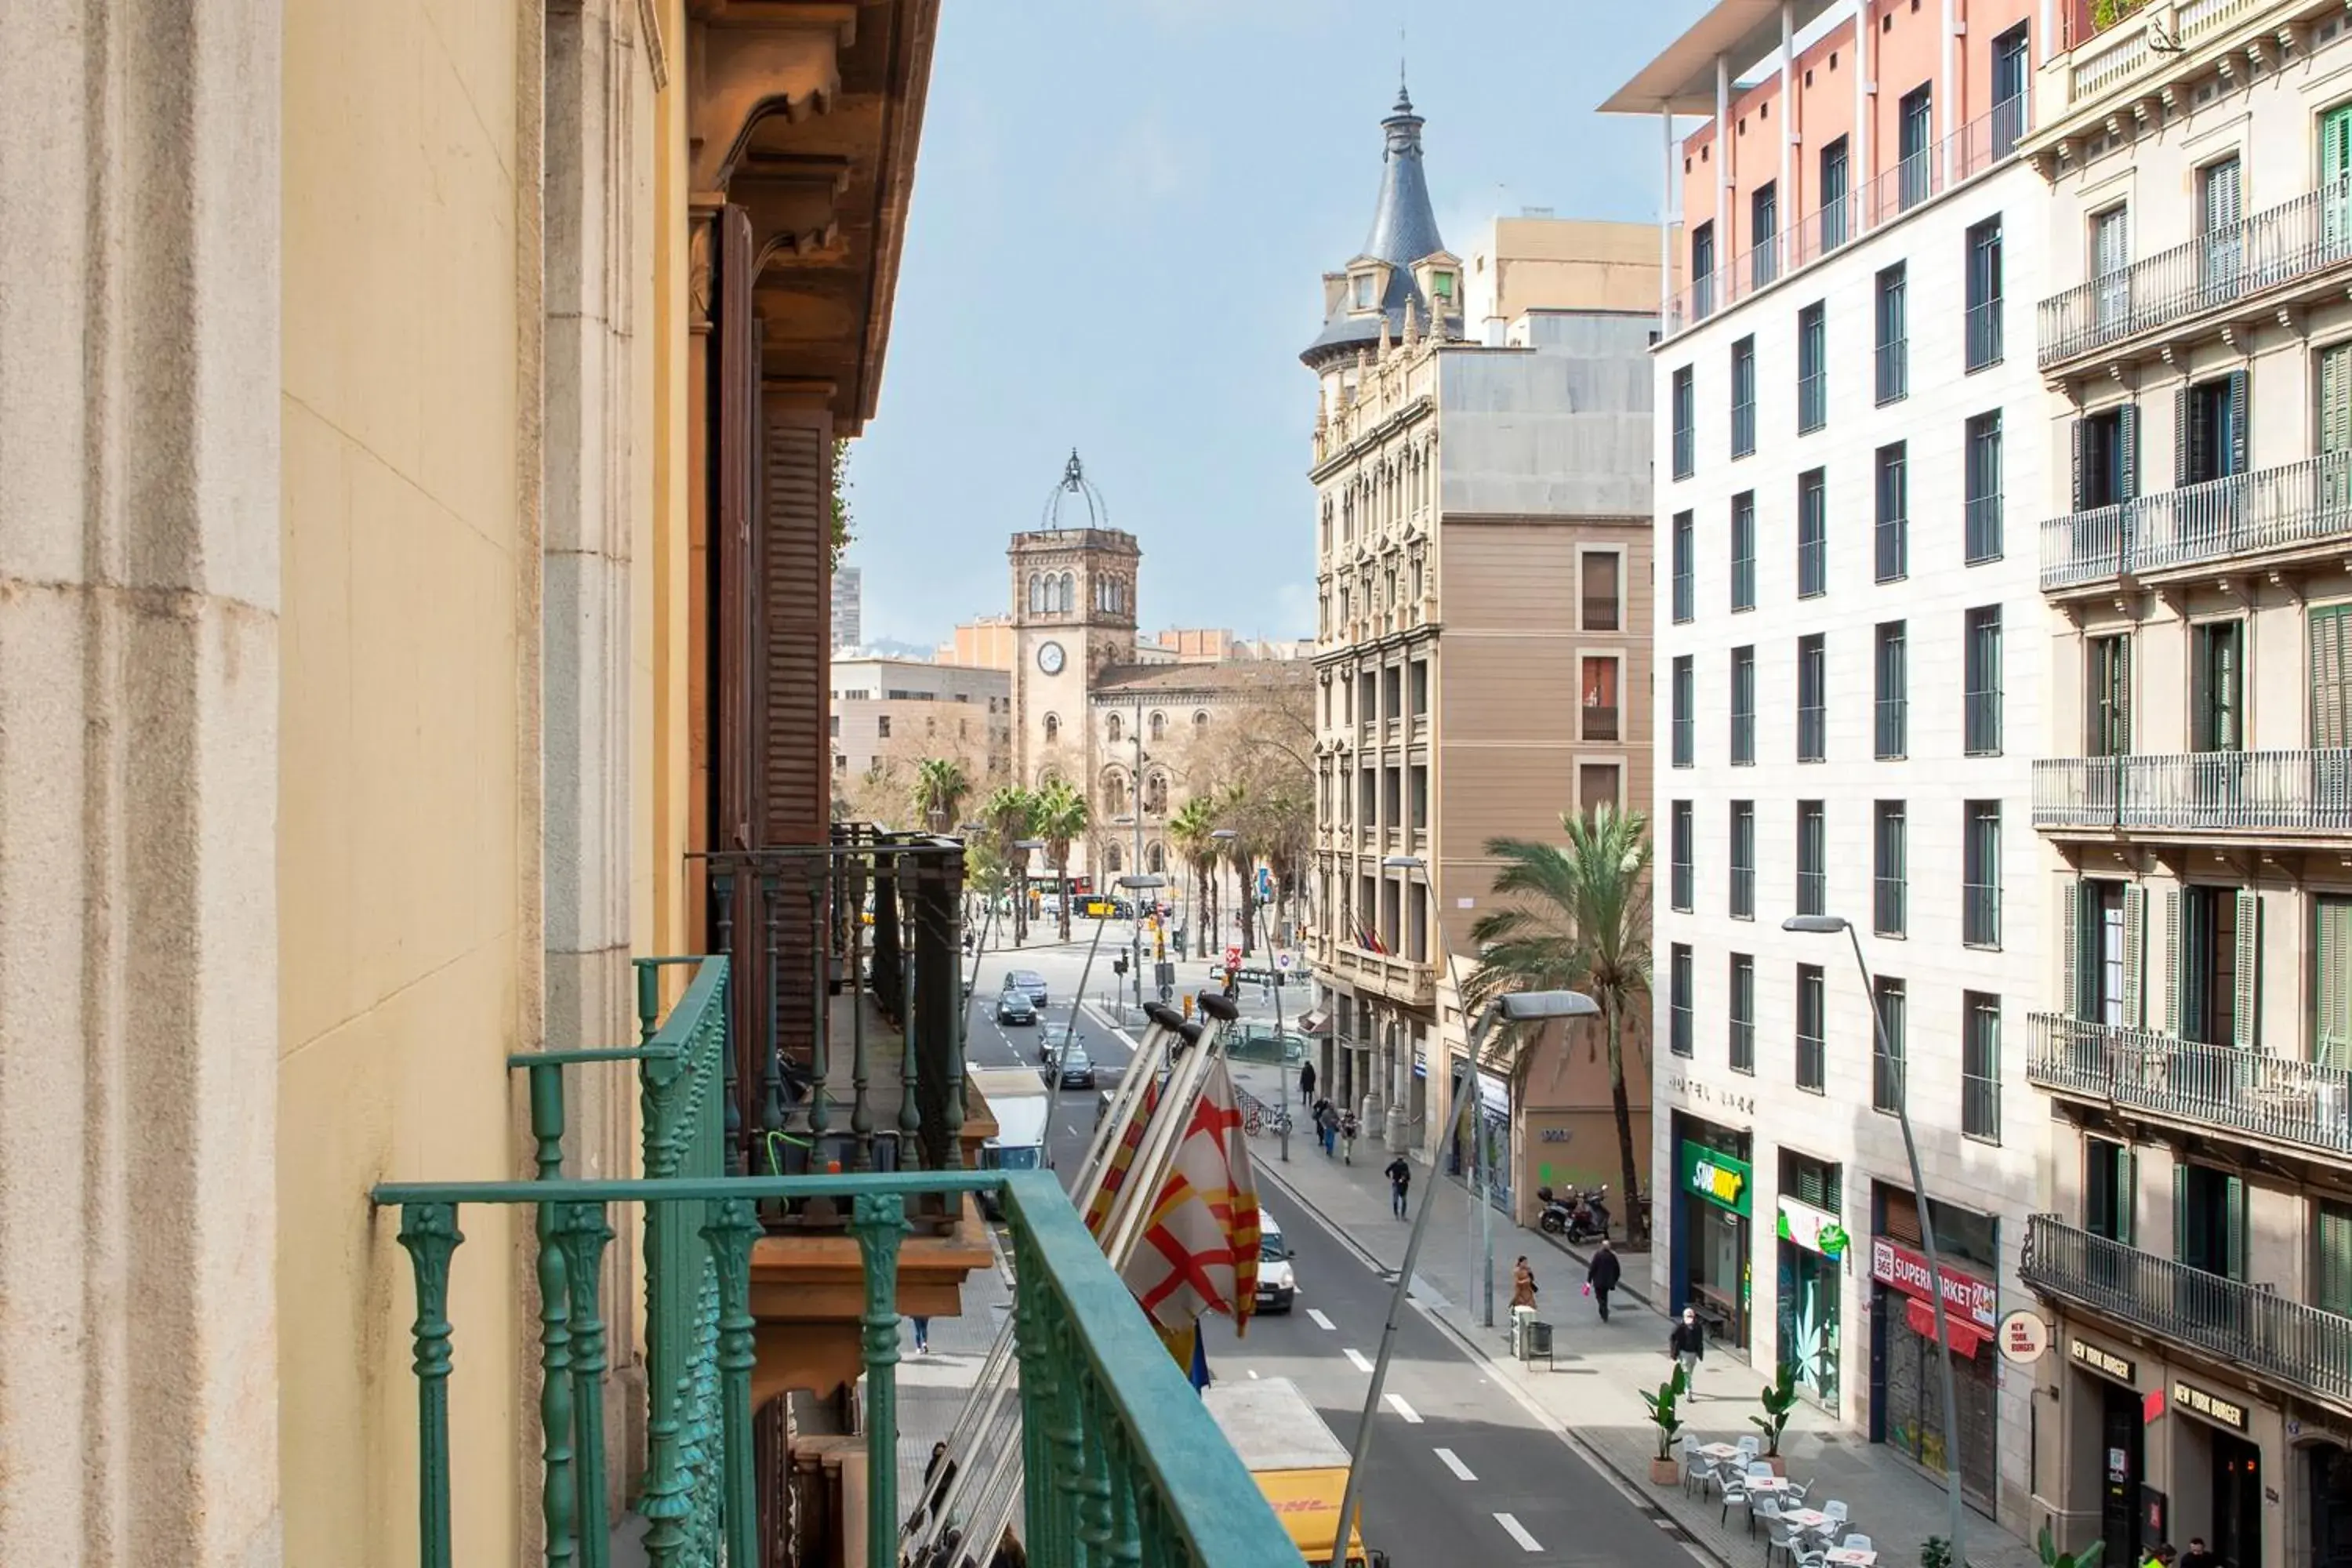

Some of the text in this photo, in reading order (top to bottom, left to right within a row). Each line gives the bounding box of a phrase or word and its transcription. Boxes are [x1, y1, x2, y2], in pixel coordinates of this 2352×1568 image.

[1693, 1160, 1742, 1204] SUBWAY
[2011, 1323, 2024, 1331] NEW
[2011, 1333, 2027, 1341] YORK
[2011, 1343, 2035, 1352] BURGER
[2072, 1340, 2129, 1380] NEW YORK BURGER
[2174, 1382, 2241, 1427] NEW YORK BURGER
